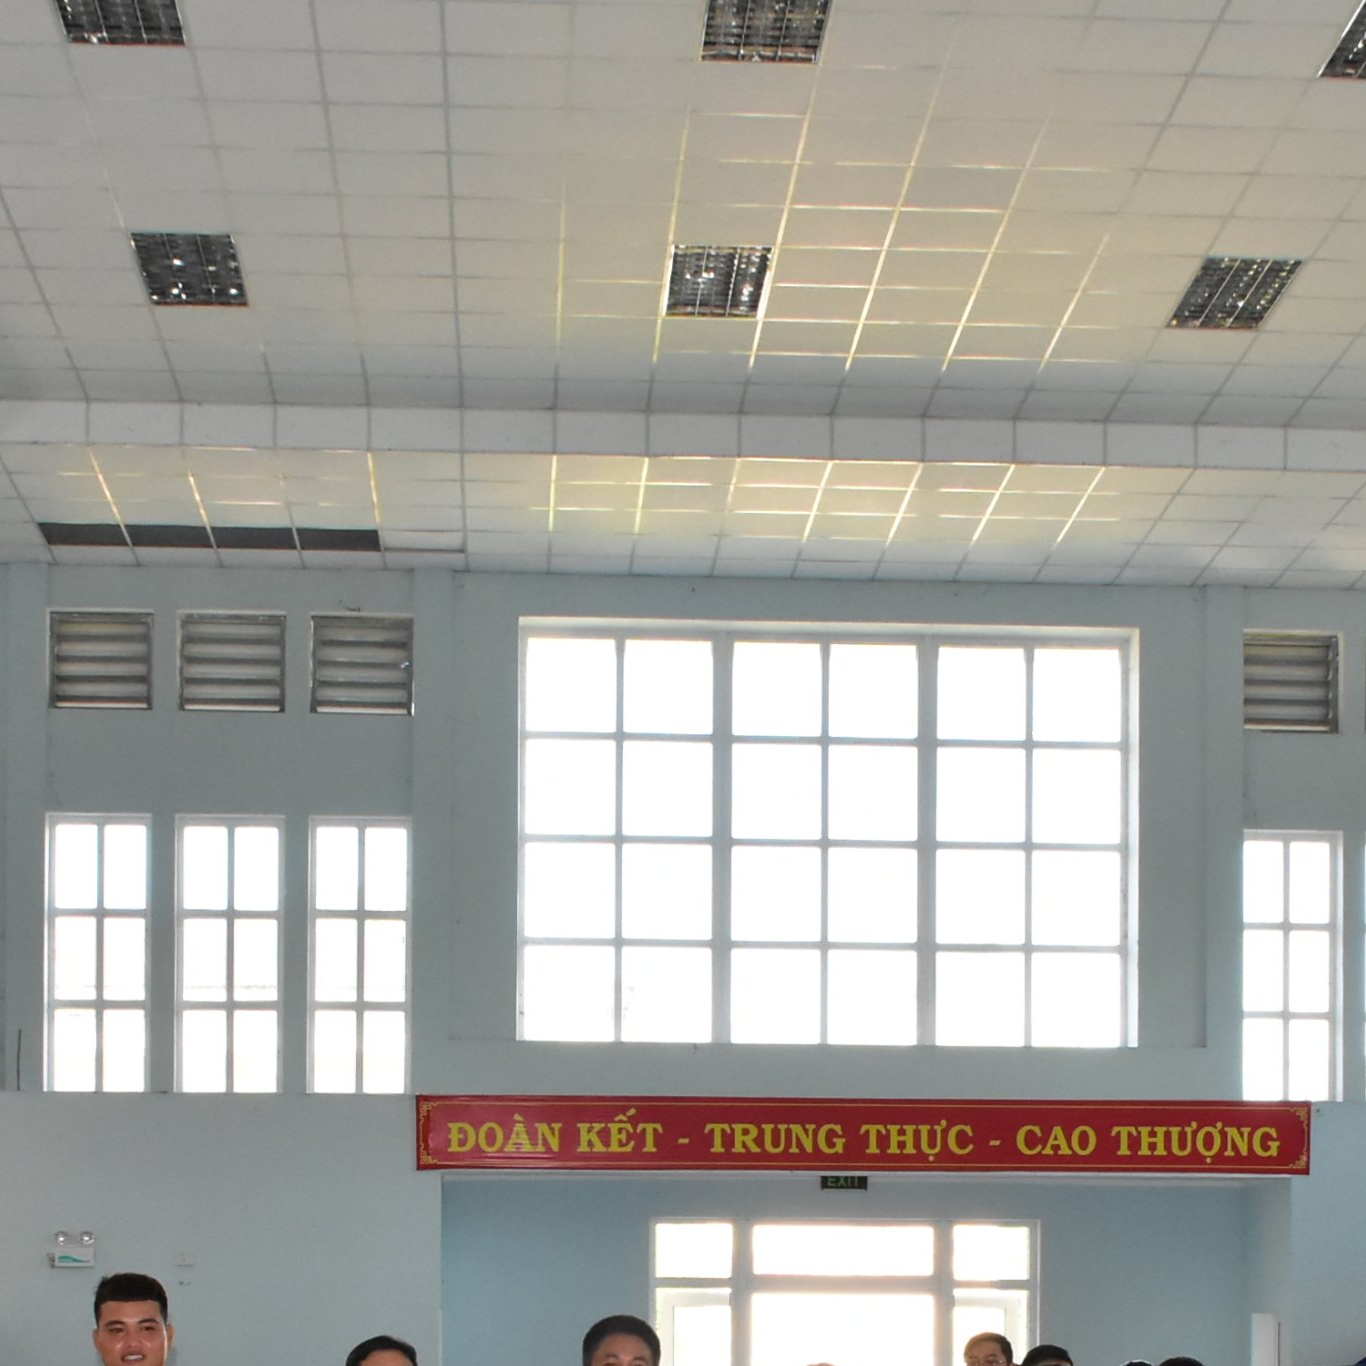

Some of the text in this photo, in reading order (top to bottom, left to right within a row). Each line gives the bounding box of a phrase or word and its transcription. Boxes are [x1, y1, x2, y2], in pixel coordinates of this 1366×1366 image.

[447, 1113, 562, 1152] ĐOÀN
[577, 1107, 663, 1152] KẾT
[704, 1123, 846, 1154] TRUNG
[860, 1119, 974, 1162] THỰC
[1016, 1125, 1097, 1156] CAO
[1111, 1121, 1281, 1164] THƯỢNG
